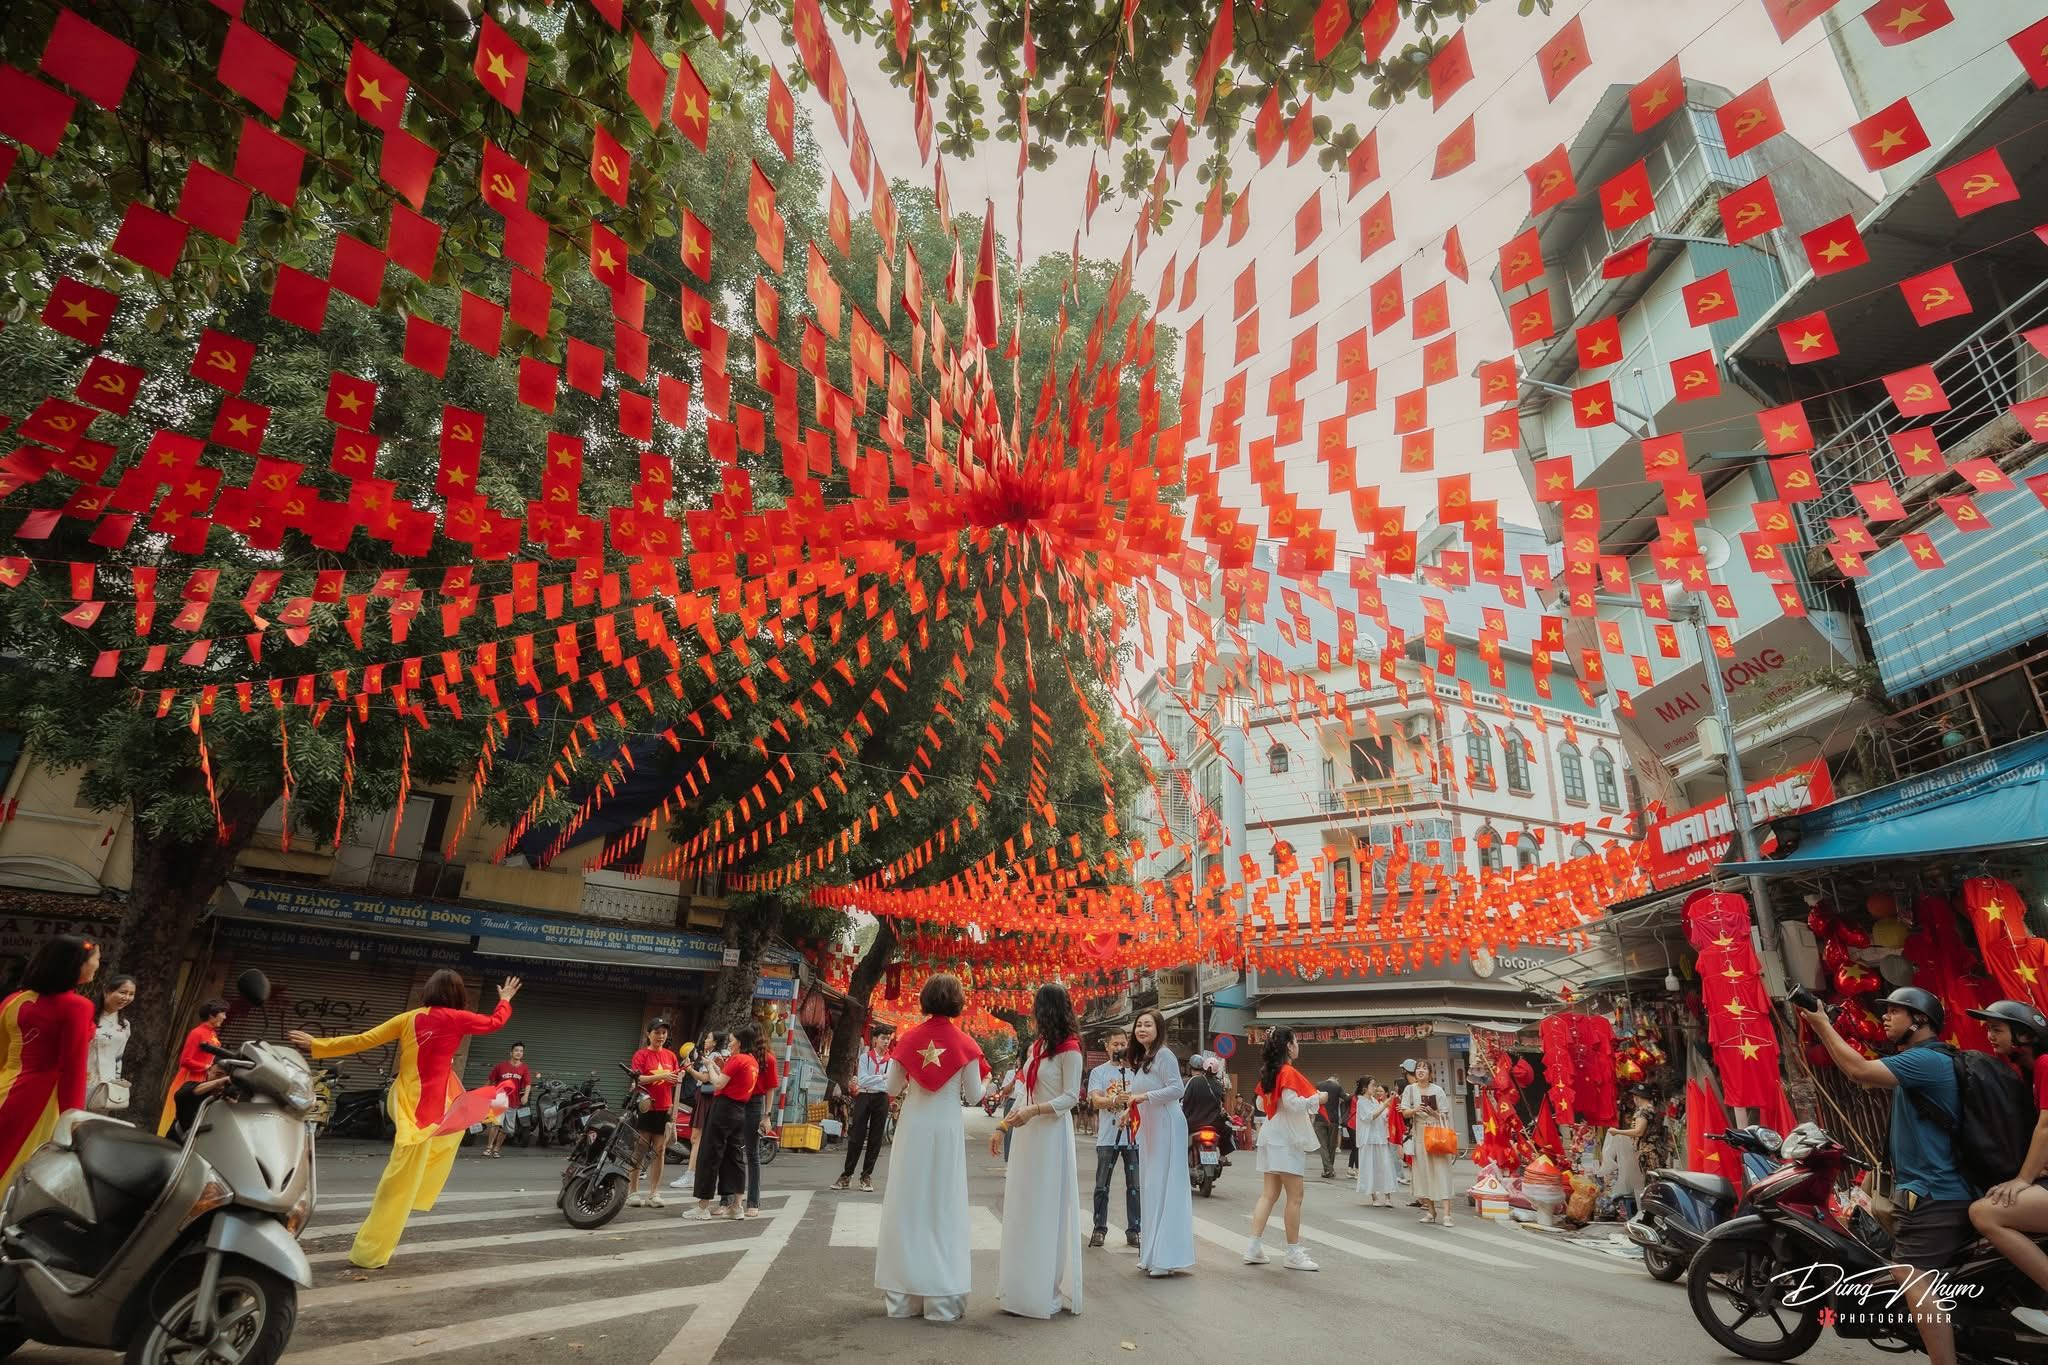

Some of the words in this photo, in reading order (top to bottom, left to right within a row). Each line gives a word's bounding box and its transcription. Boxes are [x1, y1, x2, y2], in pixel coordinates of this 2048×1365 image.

[1655, 692, 1700, 723] MAI
[1659, 813, 1708, 854] MAI
[1687, 850, 1709, 866] QUÀ
[541, 924, 584, 937] CHUYÊN
[630, 934, 654, 945] SINH
